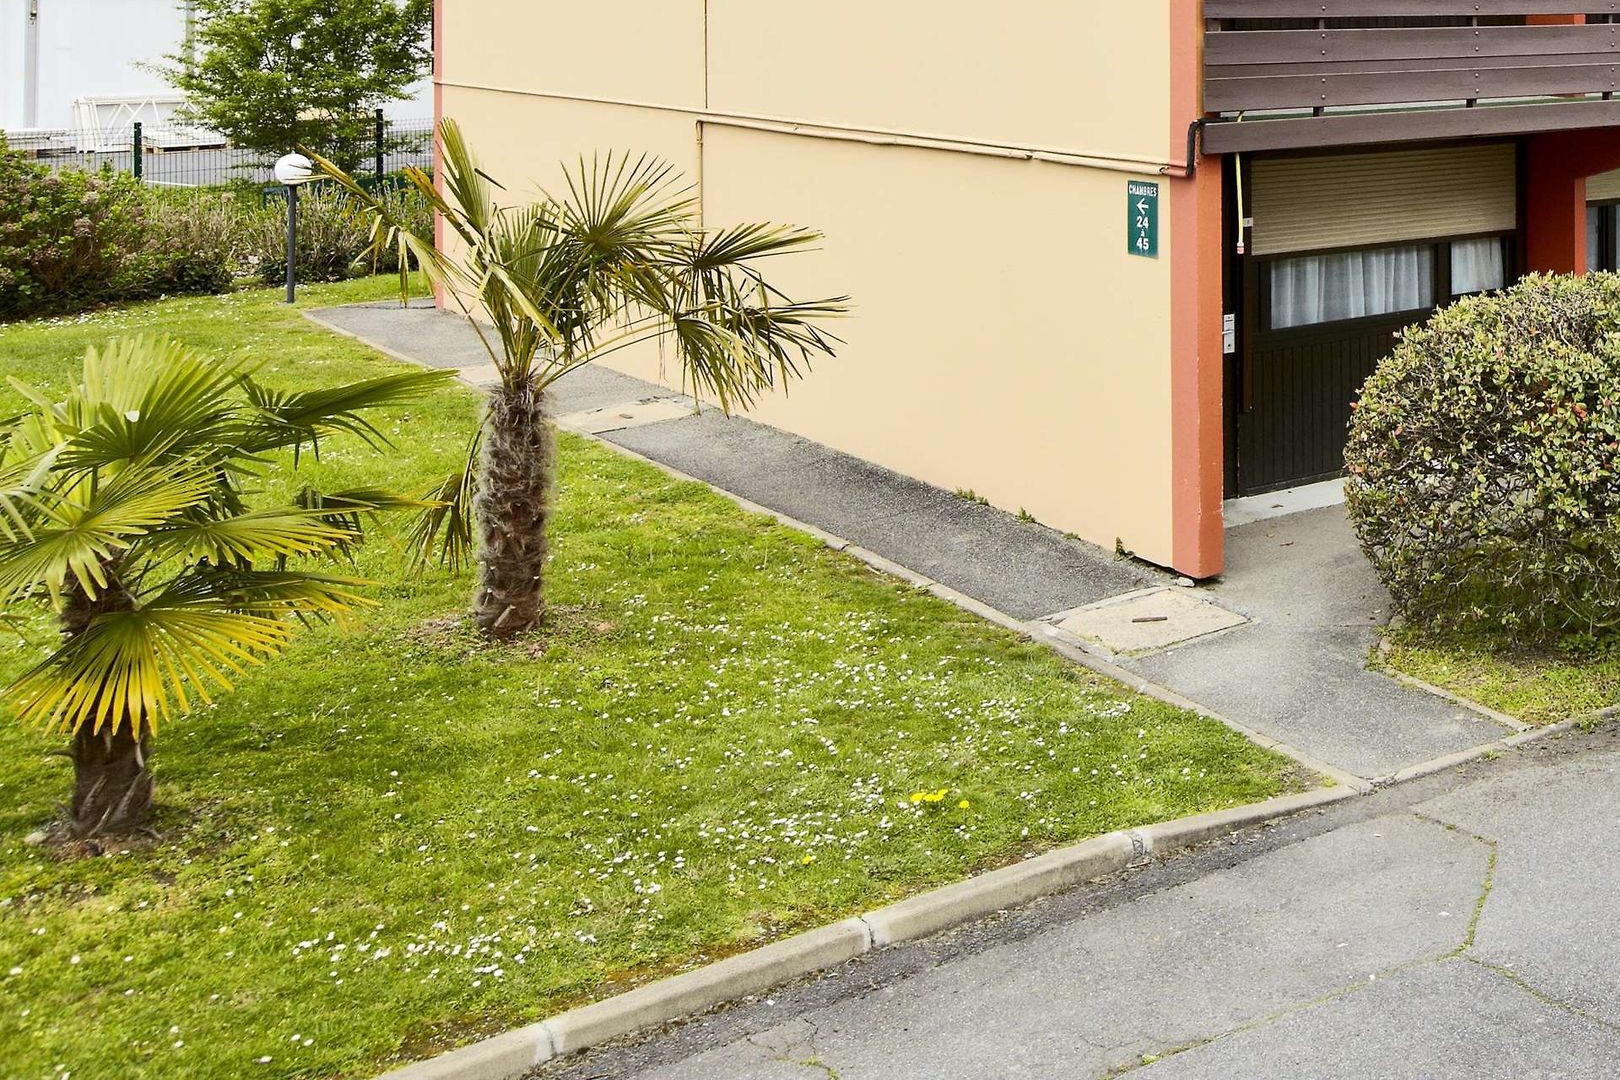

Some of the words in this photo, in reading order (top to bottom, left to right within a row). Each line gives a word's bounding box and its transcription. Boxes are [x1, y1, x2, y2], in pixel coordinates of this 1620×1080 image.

[1129, 184, 1157, 197] CHAMBRES
[1136, 215, 1149, 229] 24
[1136, 237, 1149, 250] 45
